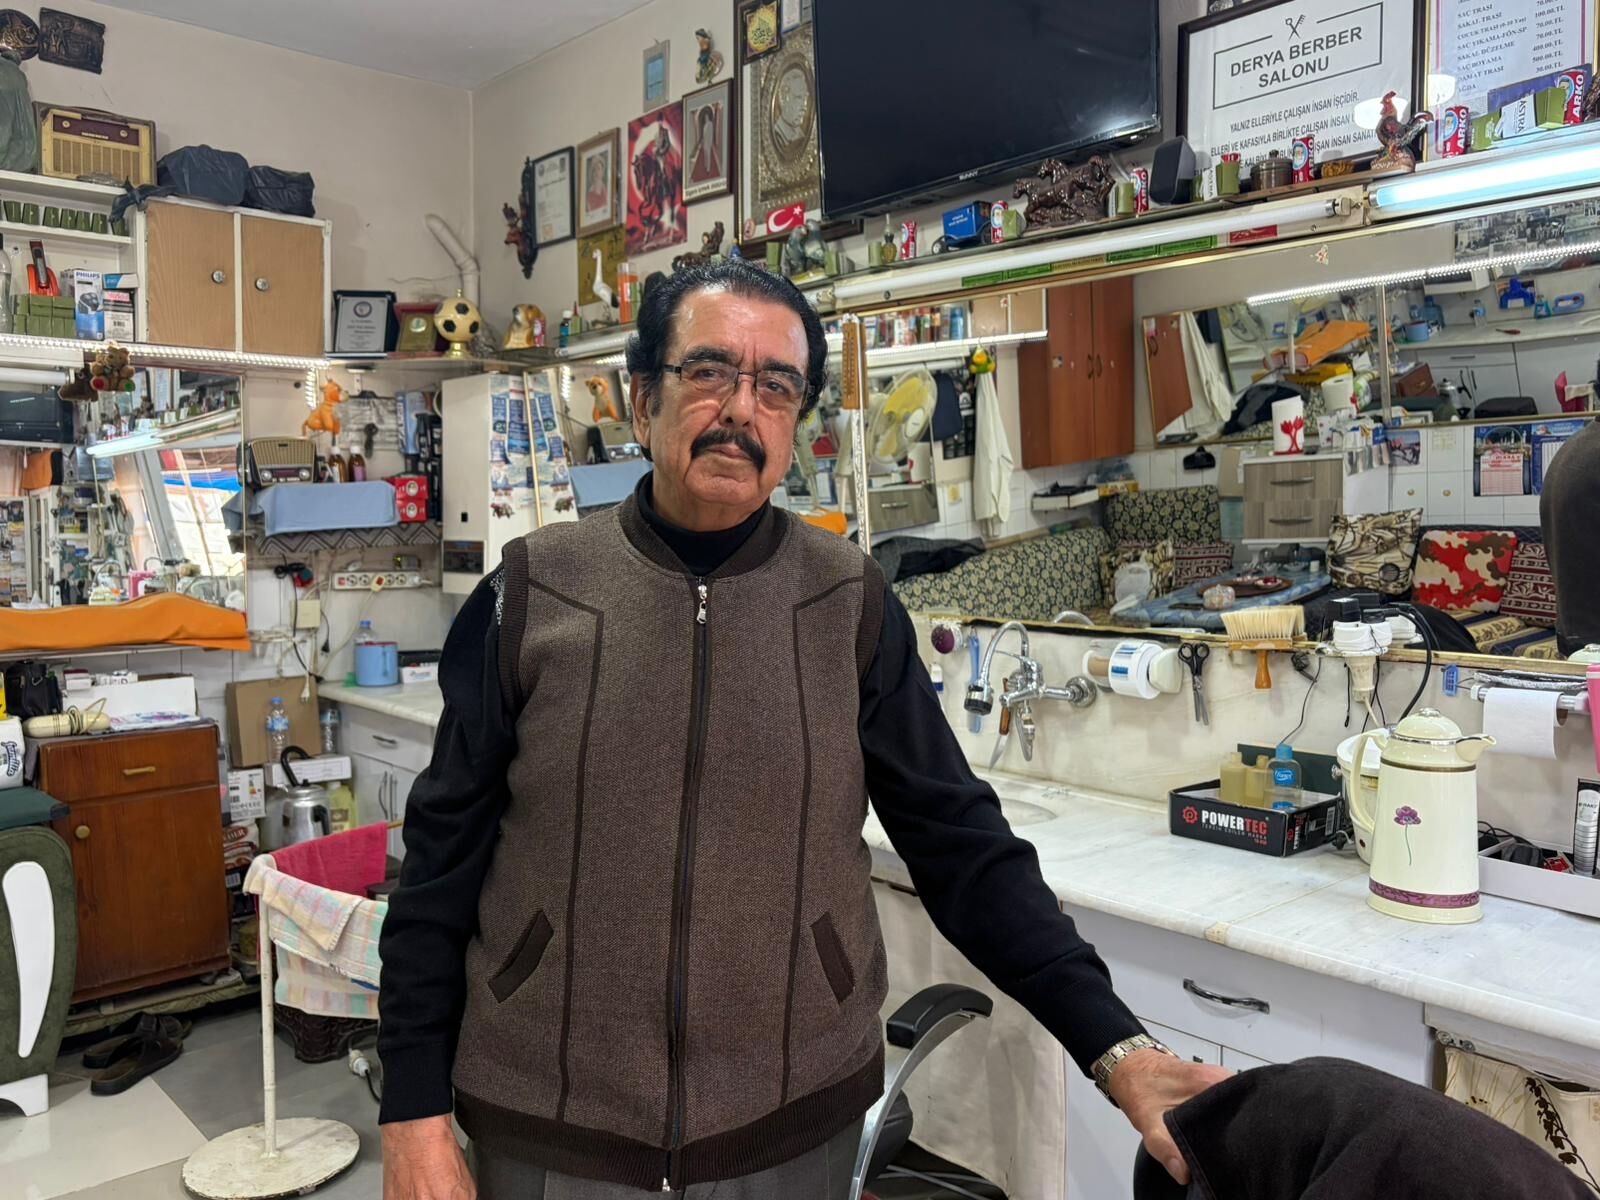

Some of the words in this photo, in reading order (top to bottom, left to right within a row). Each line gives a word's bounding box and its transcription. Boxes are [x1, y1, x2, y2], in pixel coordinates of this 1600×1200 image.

[1230, 50, 1285, 77] DERYA
[1289, 26, 1363, 59] BERBER
[1258, 56, 1330, 88] SALONU
[1572, 74, 1585, 119] ARKO
[1230, 120, 1251, 133] YALNIZ
[1251, 110, 1283, 129] ELLERİYLE
[1284, 104, 1311, 123] ÇALIŞAN
[1311, 98, 1332, 113] İNSAN
[1457, 108, 1468, 149] ARKO
[1211, 143, 1231, 157] ELLERİ
[1231, 141, 1239, 151] VE
[1239, 133, 1272, 150] KAFASIYLA
[1272, 125, 1300, 143] BİRLİKTE
[1300, 117, 1329, 135] ÇALIŞAN
[1330, 112, 1351, 129] İNSAN
[1331, 133, 1352, 148] İNSAN
[76, 271, 100, 279] PHILIPS
[1201, 809, 1268, 835] POWERTEC
